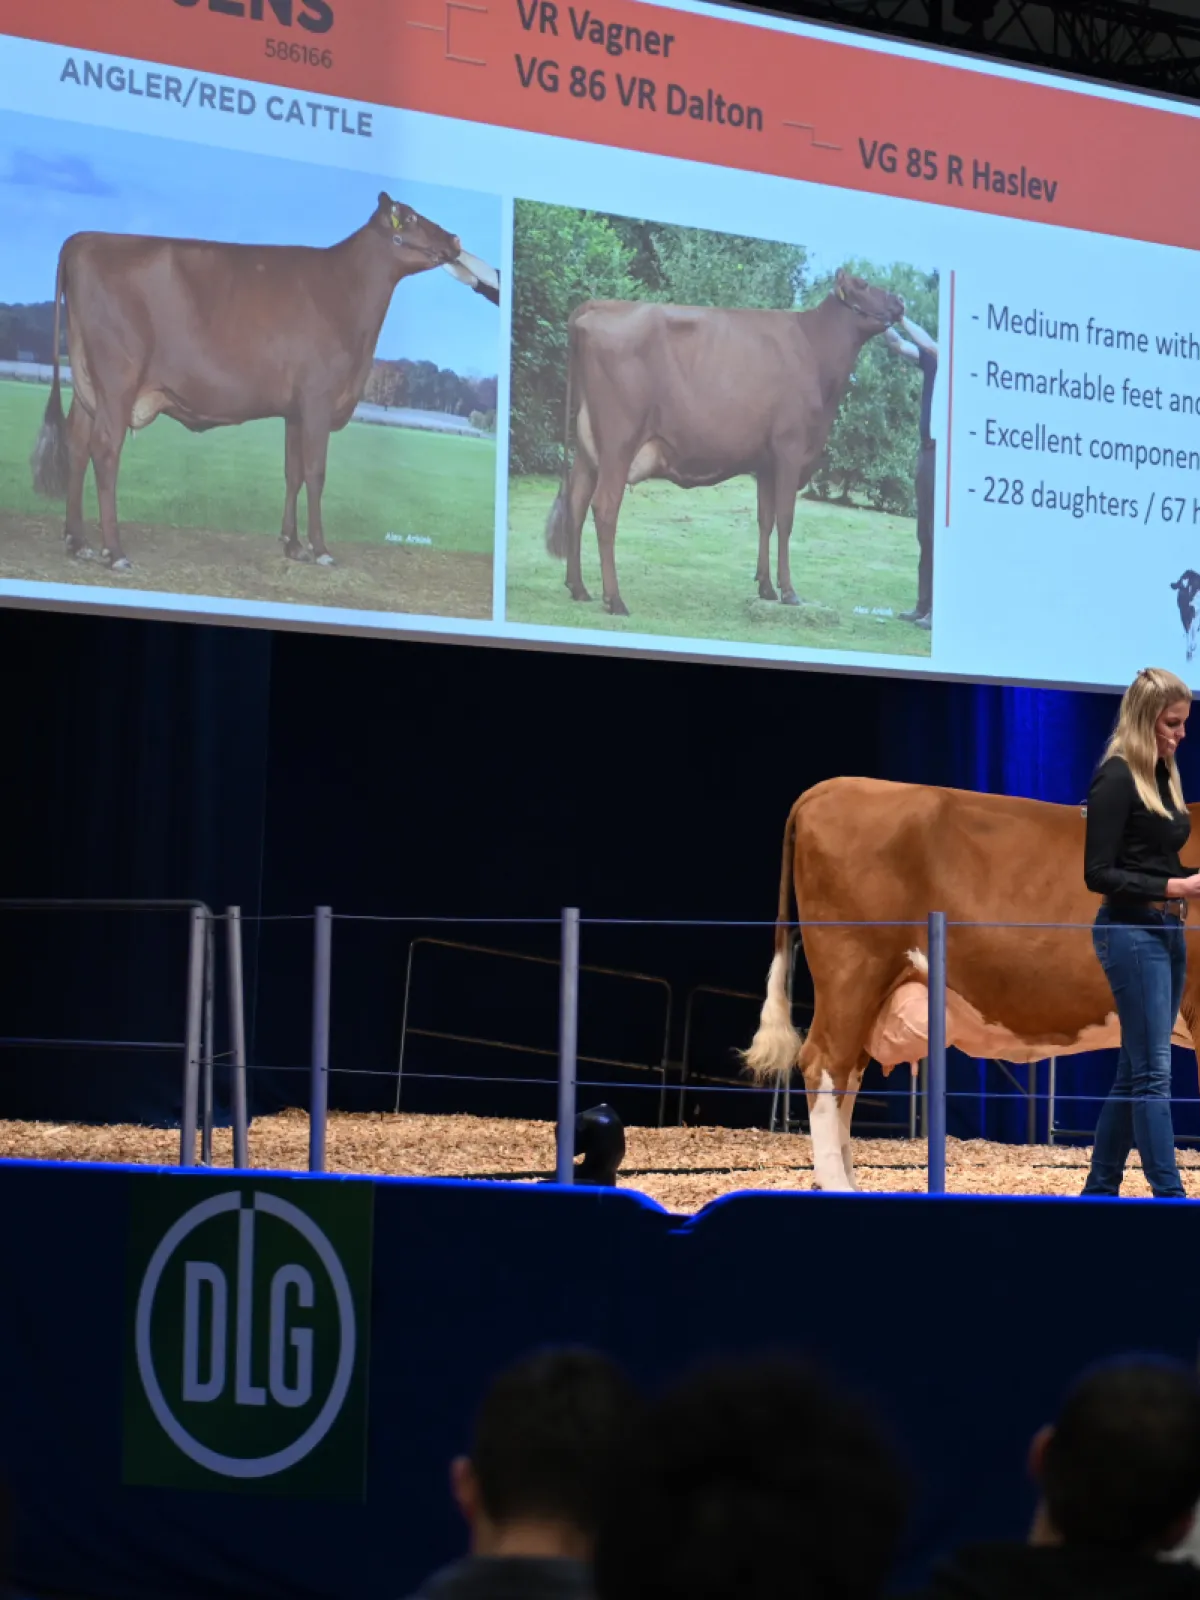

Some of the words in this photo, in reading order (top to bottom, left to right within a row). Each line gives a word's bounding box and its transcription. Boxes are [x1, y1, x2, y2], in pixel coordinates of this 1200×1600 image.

[265, 38, 333, 69] 586166
[517, 0, 558, 36] VR
[568, 6, 675, 57] Vagner
[59, 57, 256, 115] ANGLER/RED
[266, 96, 373, 137] CATTLE
[514, 53, 559, 93] VG
[569, 65, 606, 102] 86
[615, 73, 656, 111] VR
[667, 83, 763, 131] Dalton
[858, 137, 898, 174] VG
[906, 147, 938, 181] 85
[947, 154, 964, 187] R
[972, 159, 1058, 203] Haslev
[987, 303, 1079, 342] Medium
[1087, 317, 1148, 353] frame
[1156, 332, 1200, 360] with
[986, 360, 1115, 404] Remarkable
[1122, 378, 1163, 410] feet
[985, 418, 1082, 456] Excellent
[983, 475, 1024, 505] 228
[1031, 480, 1139, 518] daughters
[1144, 492, 1155, 524] /
[1161, 496, 1186, 523] 67
[183, 1208, 314, 1408] DLG
